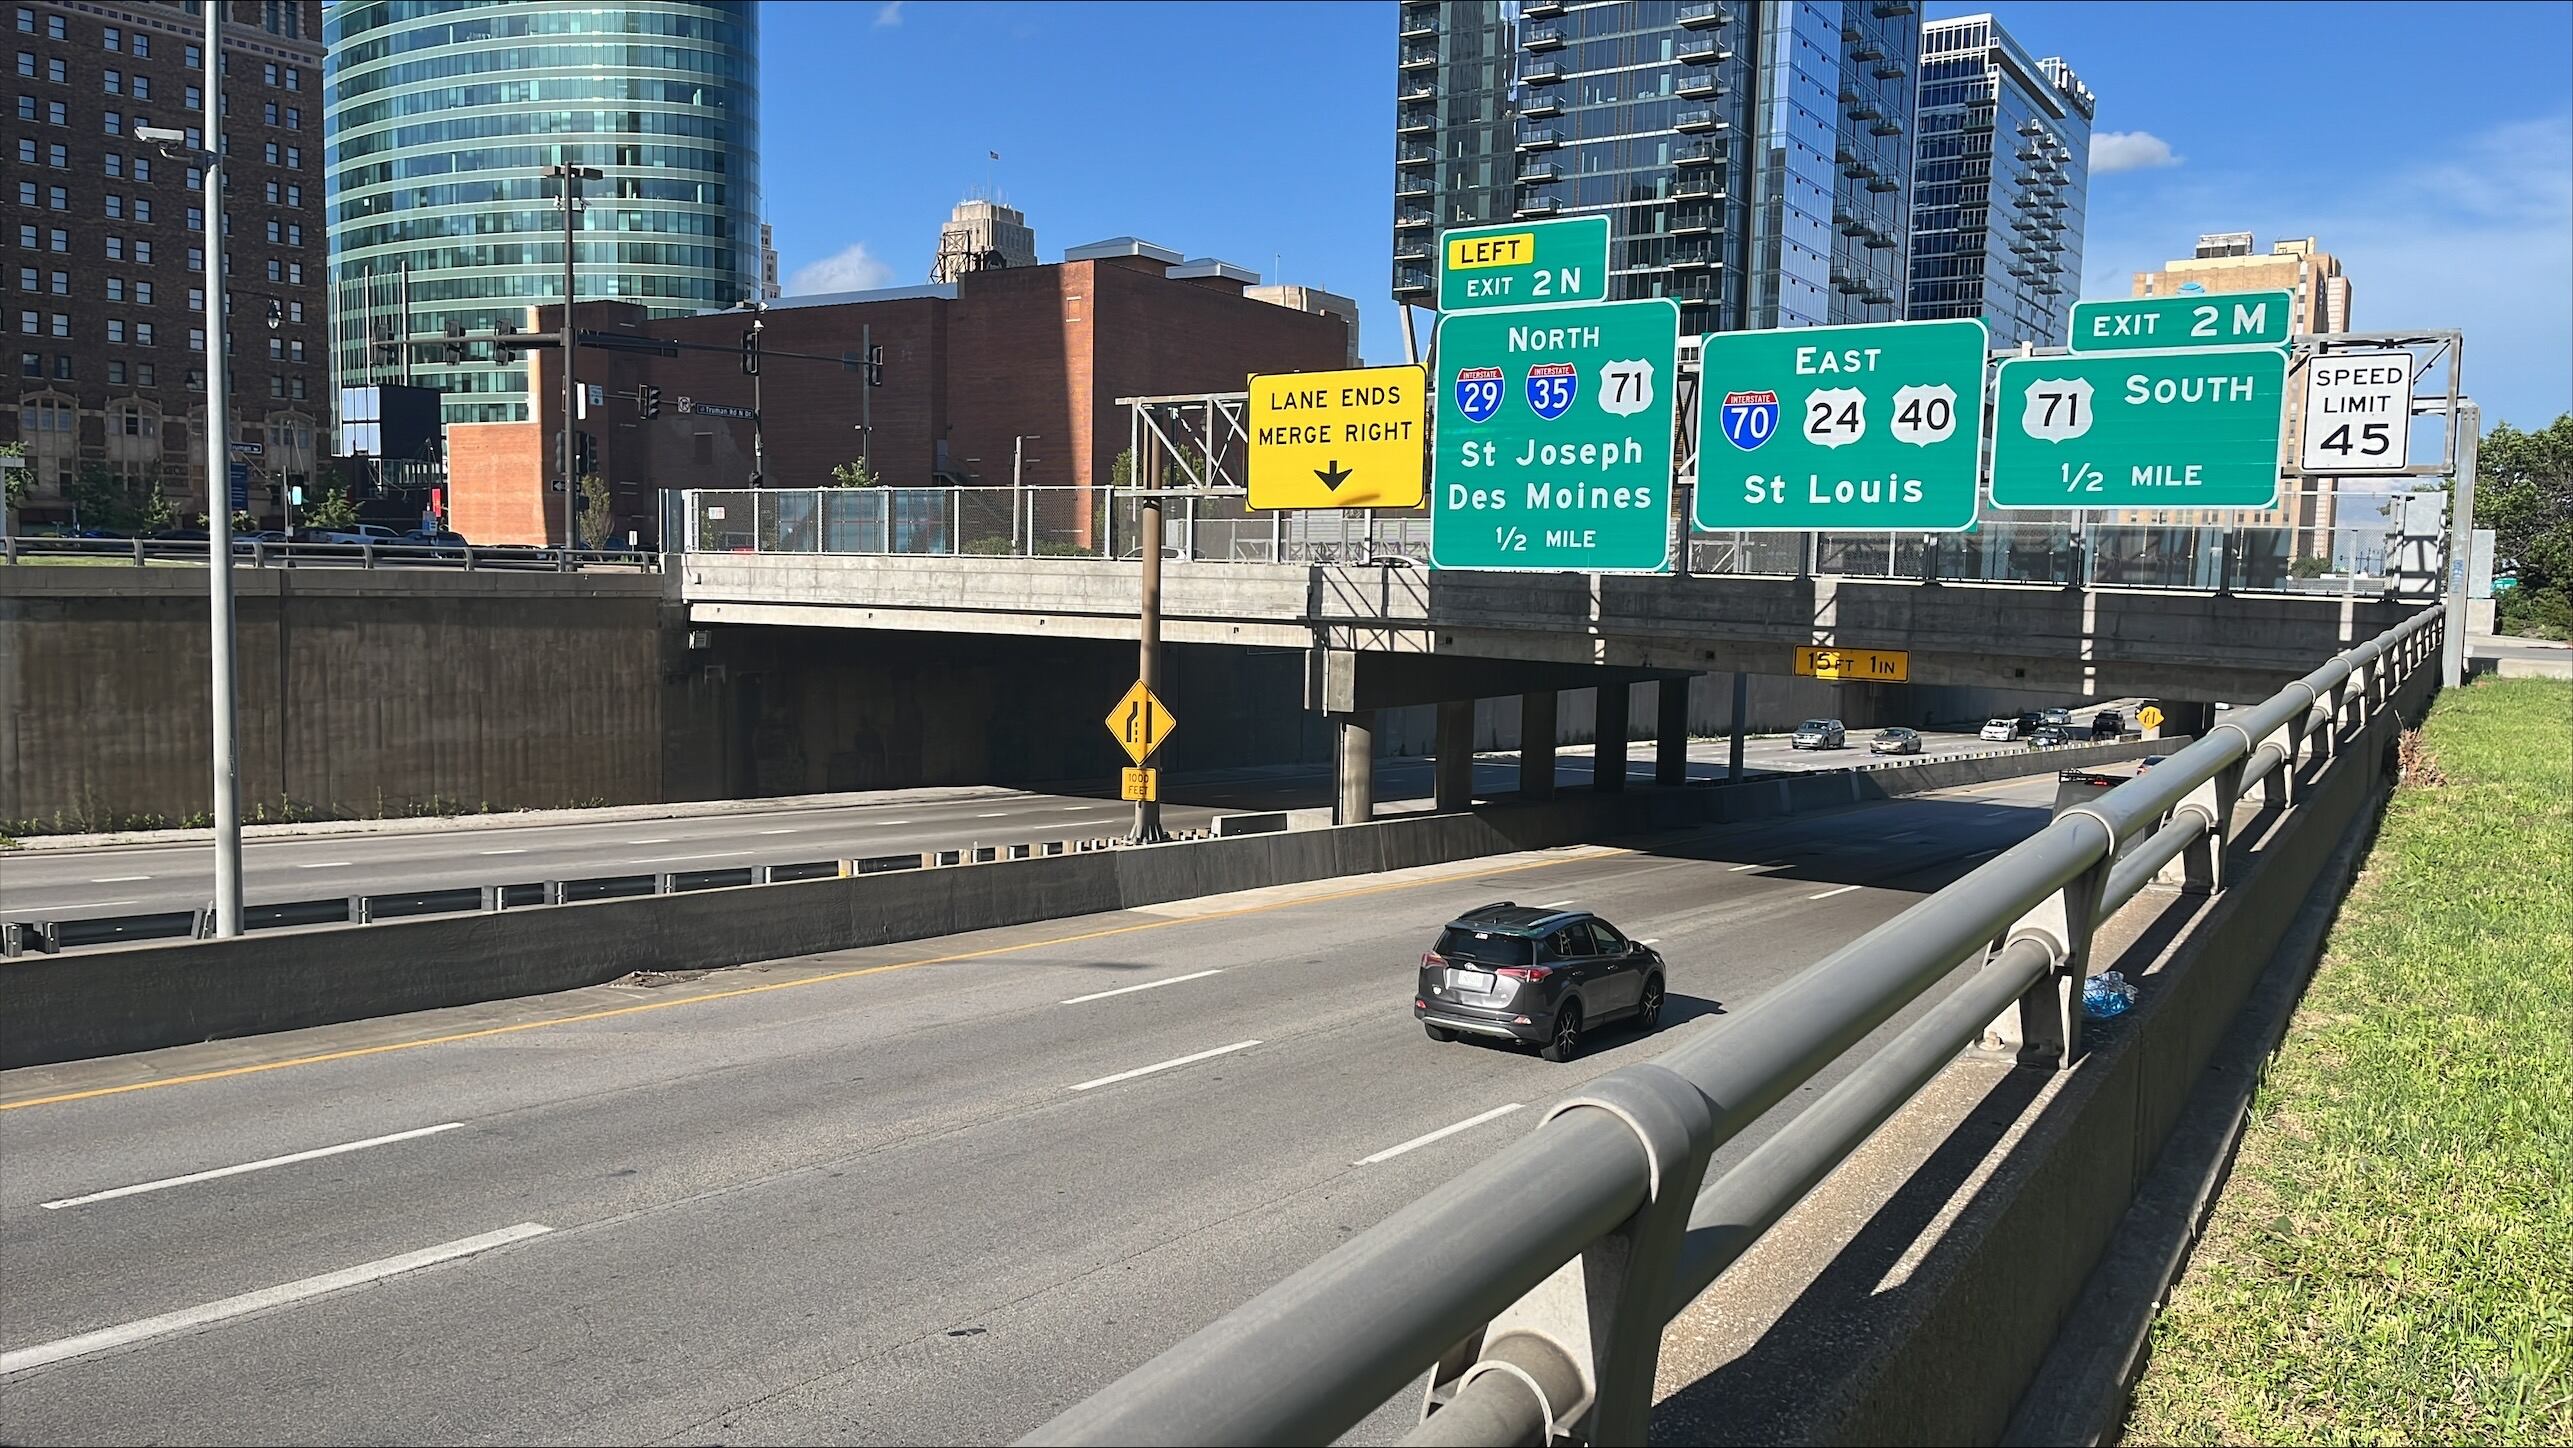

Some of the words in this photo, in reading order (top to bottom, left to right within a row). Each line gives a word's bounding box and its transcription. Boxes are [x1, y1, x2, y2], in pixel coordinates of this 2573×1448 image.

[1461, 239, 1521, 265] LEFT
[1466, 276, 1514, 298] EXIT
[2093, 312, 2161, 338] EXIT
[1508, 326, 1600, 353] NORTH
[1534, 366, 1570, 376] INTERSTATE
[1795, 346, 1882, 375] EAST
[1463, 370, 1498, 380] INTERSTATE
[2316, 367, 2403, 387] SPEED
[1271, 389, 1328, 411] LANE
[1341, 386, 1401, 407] ENDS
[1463, 382, 1498, 413] 29
[1534, 378, 1569, 410] 35
[1610, 371, 1642, 403] 71
[1730, 394, 1771, 404] INTERSTATE
[2124, 374, 2254, 405] SOUTH
[2038, 392, 2079, 428] 71
[2323, 395, 2392, 413] LIMIT
[1730, 406, 1770, 440] 70
[1810, 401, 1859, 434] 24
[1898, 398, 1951, 432] 40
[1259, 425, 1331, 446] MERGE
[1345, 421, 1413, 442] RIGHT
[2319, 423, 2390, 456] 45
[1461, 440, 1496, 468] St
[1515, 436, 1643, 472] Joseph
[2131, 464, 2203, 487] MILE
[1448, 483, 1507, 510] Des
[1526, 481, 1652, 510] Moines
[1744, 474, 1786, 504] St
[1808, 473, 1924, 504] Louis
[1545, 529, 1597, 548] MILE
[1128, 785, 1149, 795] FEET
[1129, 773, 1149, 783] 1000
